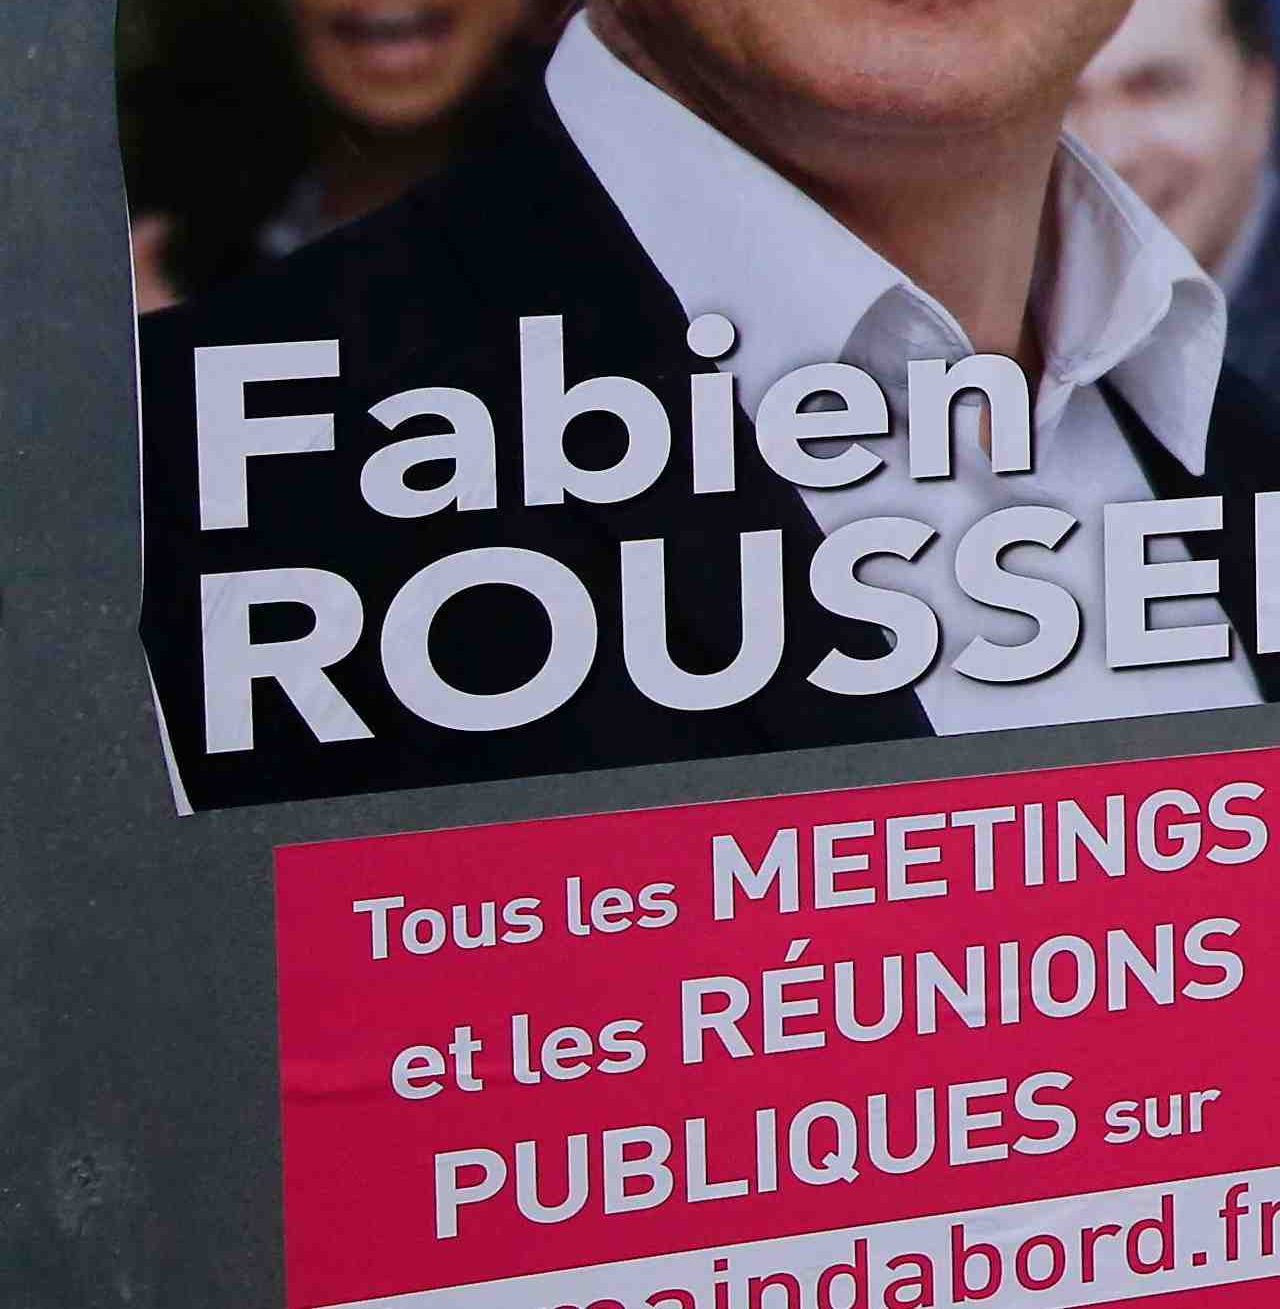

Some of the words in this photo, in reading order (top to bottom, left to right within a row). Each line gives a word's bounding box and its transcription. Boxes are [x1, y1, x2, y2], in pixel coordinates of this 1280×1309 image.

[193, 312, 1032, 532] Fabien
[353, 893, 544, 961] Tous
[567, 875, 678, 939] les
[711, 781, 1269, 922] MEETINGS
[390, 1034, 484, 1100] et
[513, 1013, 646, 1087] les
[681, 916, 1245, 1066] RÉUNIONS
[434, 1070, 1078, 1241] PUBLIQUES
[1103, 1086, 1222, 1148] sur
